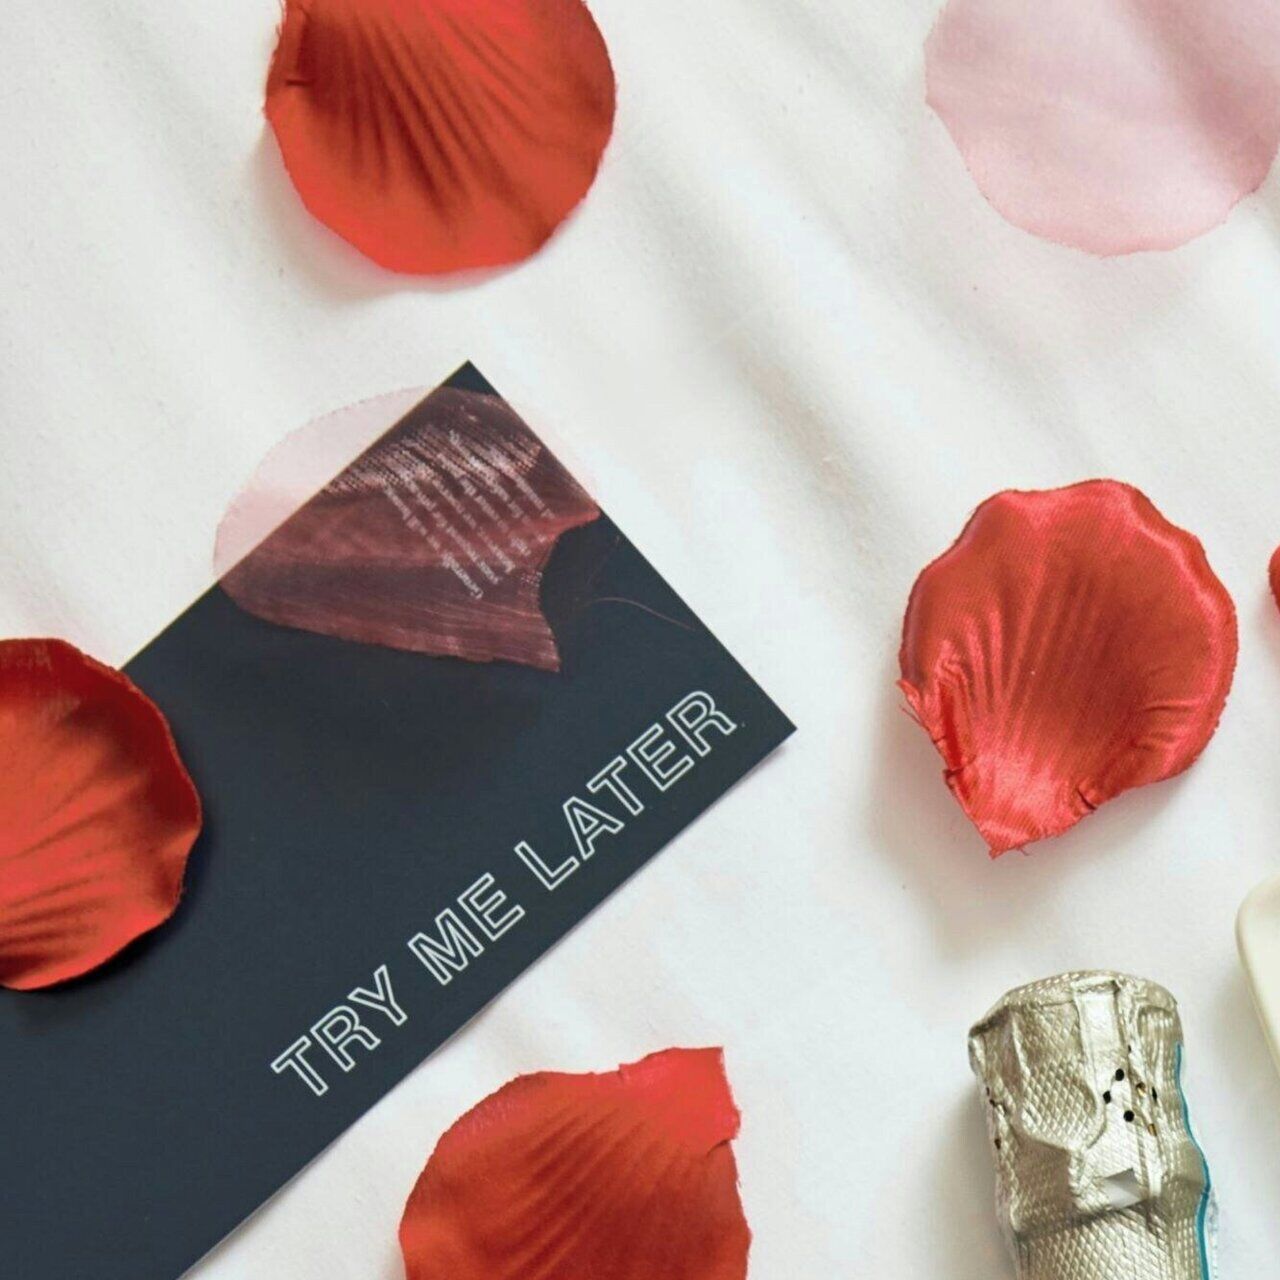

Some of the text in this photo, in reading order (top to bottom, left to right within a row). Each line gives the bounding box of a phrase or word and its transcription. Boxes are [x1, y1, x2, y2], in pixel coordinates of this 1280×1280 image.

[270, 689, 738, 1098] TRY ME LATER
